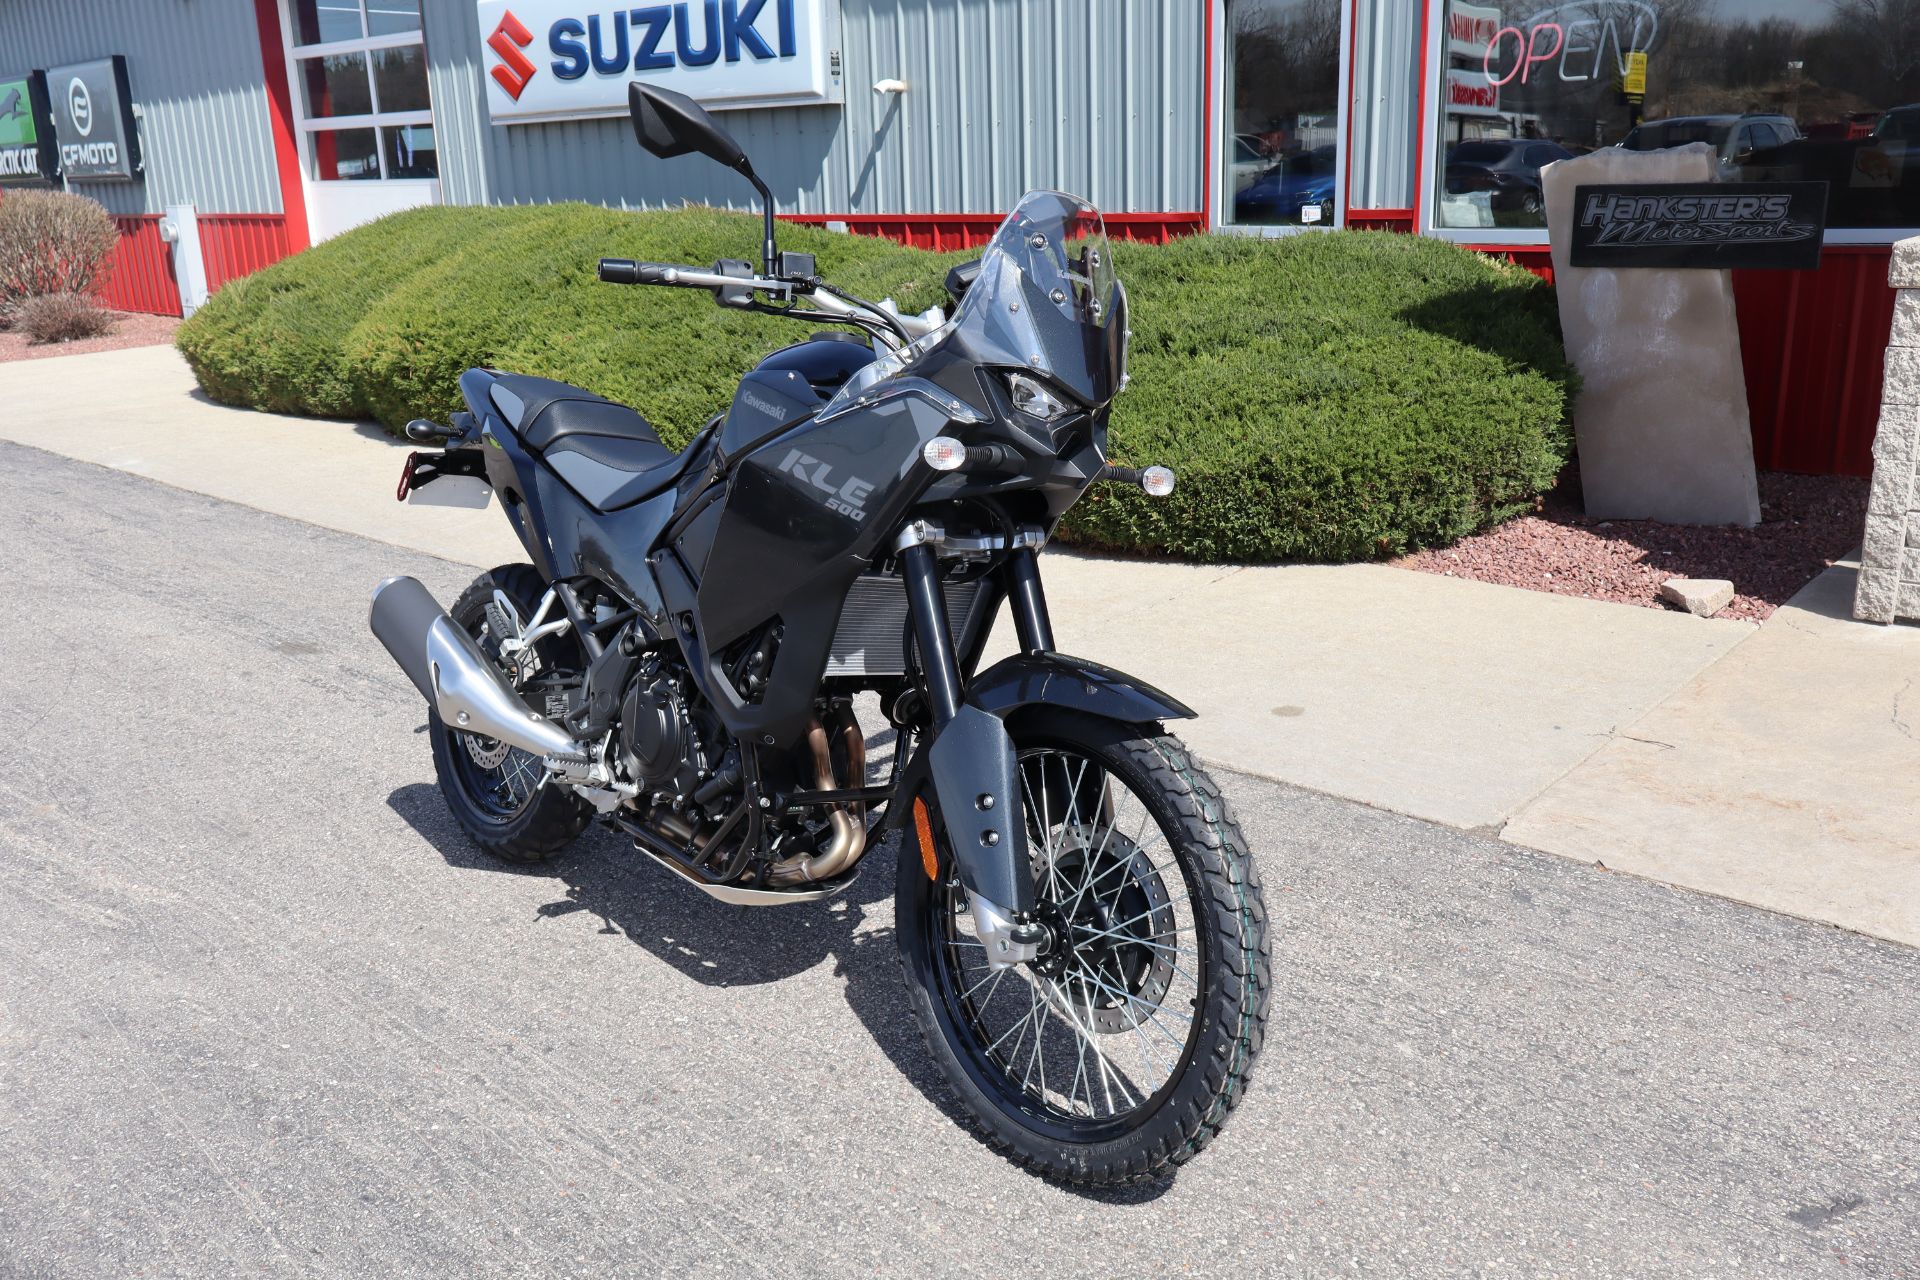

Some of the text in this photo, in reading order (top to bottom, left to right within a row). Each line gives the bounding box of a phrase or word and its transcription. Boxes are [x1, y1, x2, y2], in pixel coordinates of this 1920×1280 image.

[548, 0, 797, 80] SUZUKI
[1484, 15, 1643, 87] OPEN
[0, 147, 38, 175] RCTIC CAT
[62, 142, 118, 166] CFMOTO
[741, 389, 787, 421] Kawasaki
[778, 449, 875, 507] KLE
[824, 498, 866, 522] 500
